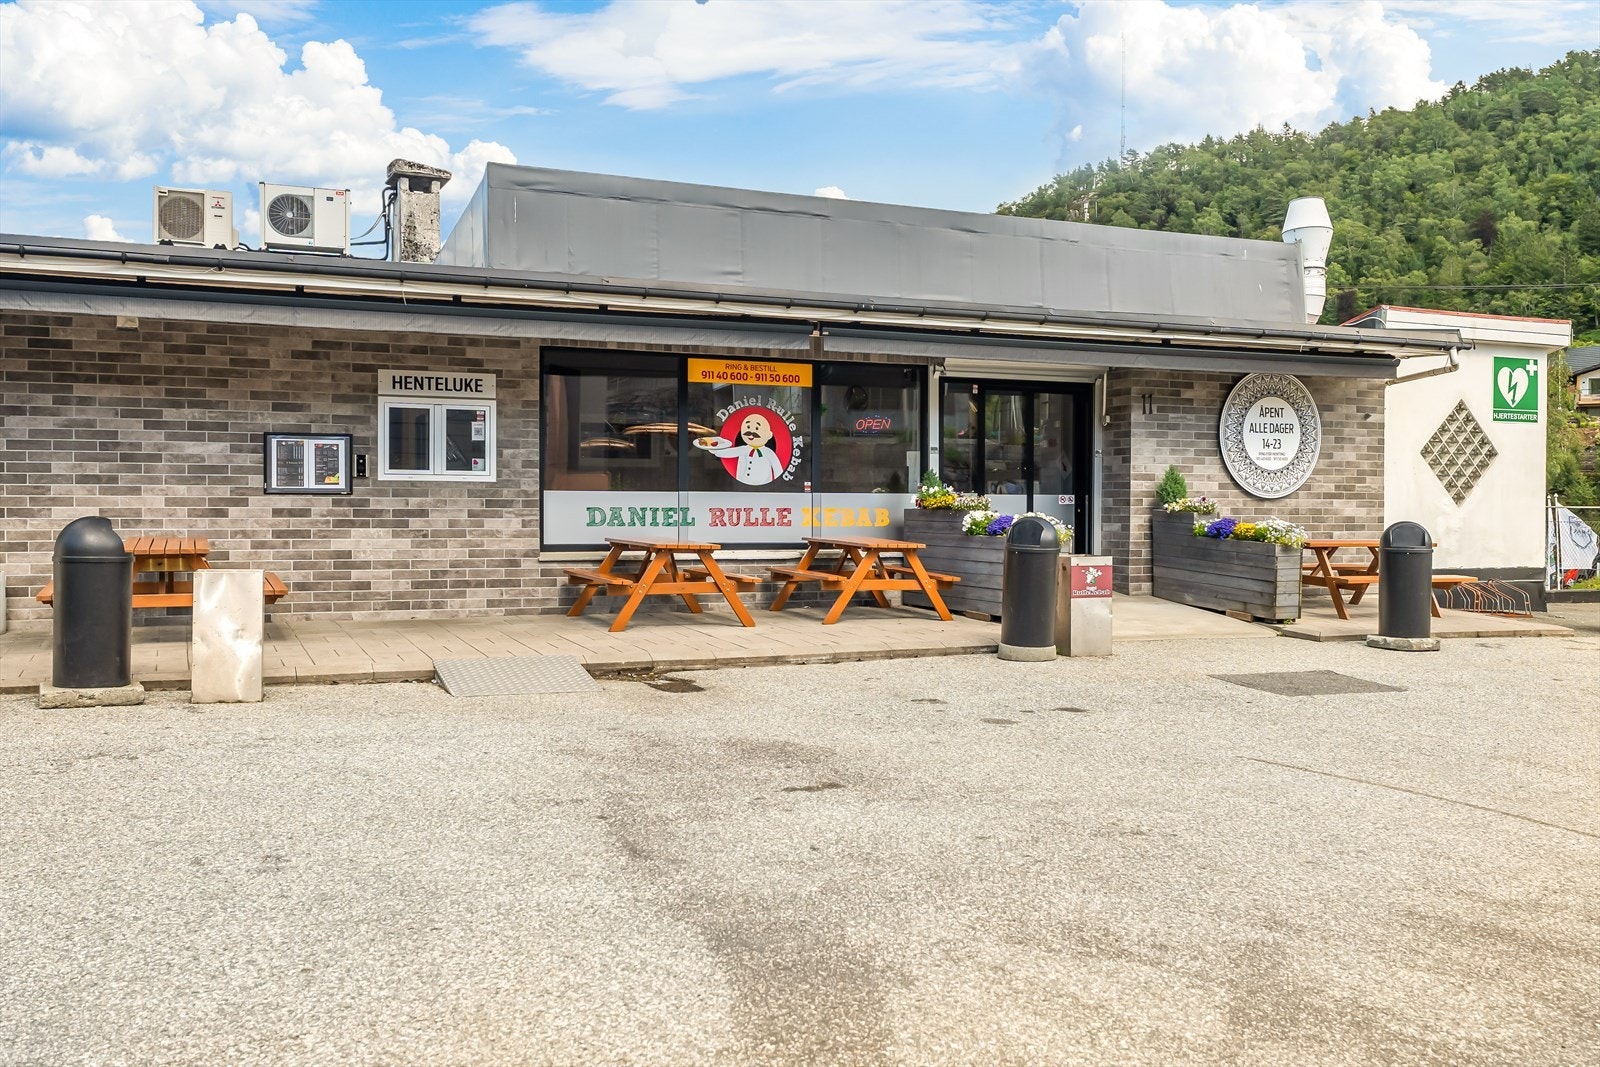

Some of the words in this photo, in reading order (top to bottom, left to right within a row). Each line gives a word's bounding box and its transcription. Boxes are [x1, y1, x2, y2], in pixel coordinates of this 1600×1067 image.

[725, 363, 742, 371] RING
[750, 364, 777, 372] BESTILL
[701, 370, 714, 380] 911
[716, 371, 728, 380] 40
[730, 371, 748, 381] 600
[755, 372, 767, 382] 911
[769, 373, 781, 383] 50
[782, 374, 800, 383] 600
[392, 375, 483, 393] HENTELUKE
[1141, 394, 1153, 415] 11
[1259, 405, 1285, 418] ÅPENT
[1493, 412, 1538, 421] HJERTESTARTER
[855, 418, 892, 430] OPEN
[1249, 422, 1268, 434] ALLE
[1269, 423, 1295, 434] DAGER
[716, 394, 762, 422] Daniel
[766, 397, 797, 432] Rulle
[782, 435, 803, 481] Kebab
[1262, 438, 1282, 450] 14-23
[586, 507, 695, 527] DANIEL
[709, 507, 792, 527] RULLE
[801, 507, 890, 527] KEBAB
